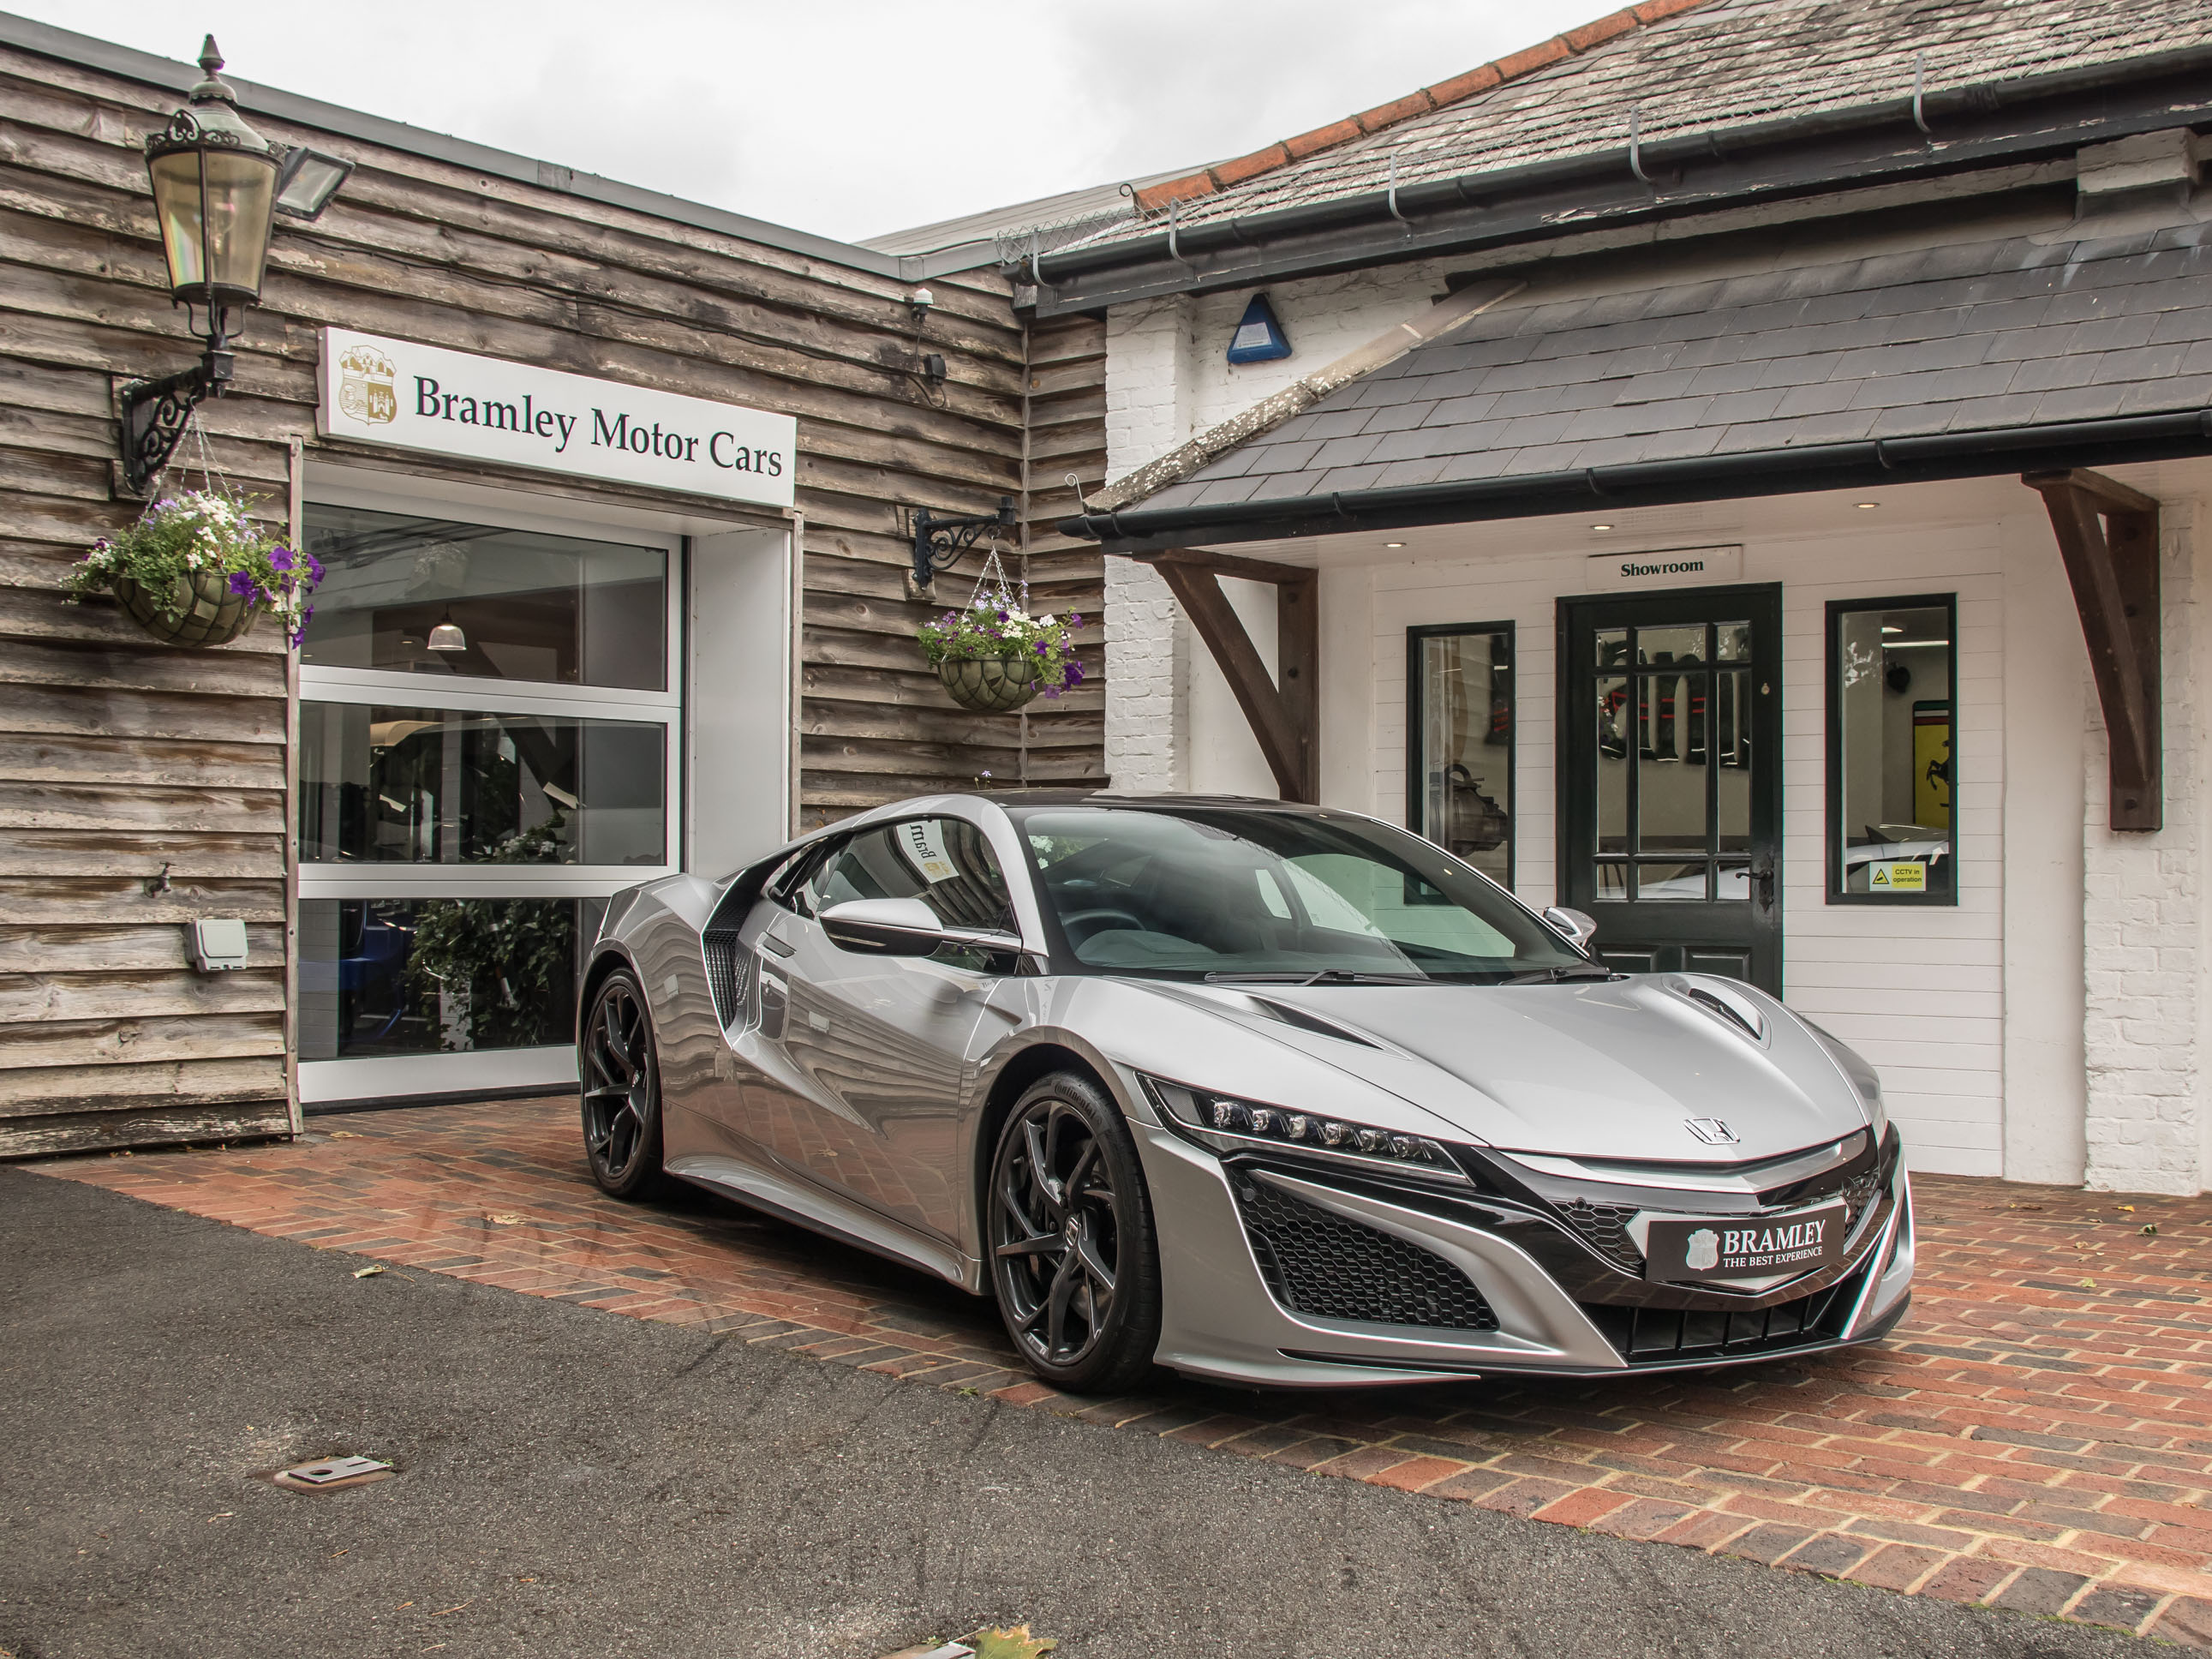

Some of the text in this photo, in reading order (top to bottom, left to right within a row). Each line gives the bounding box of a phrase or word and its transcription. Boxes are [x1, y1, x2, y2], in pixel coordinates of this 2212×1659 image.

[413, 374, 783, 477] Bramley Motor Cars
[1620, 560, 1704, 577] Showroom
[1723, 1219, 1826, 1255] BRAMLEY
[1723, 1246, 1823, 1268] THE BEST EXPERIENCE
